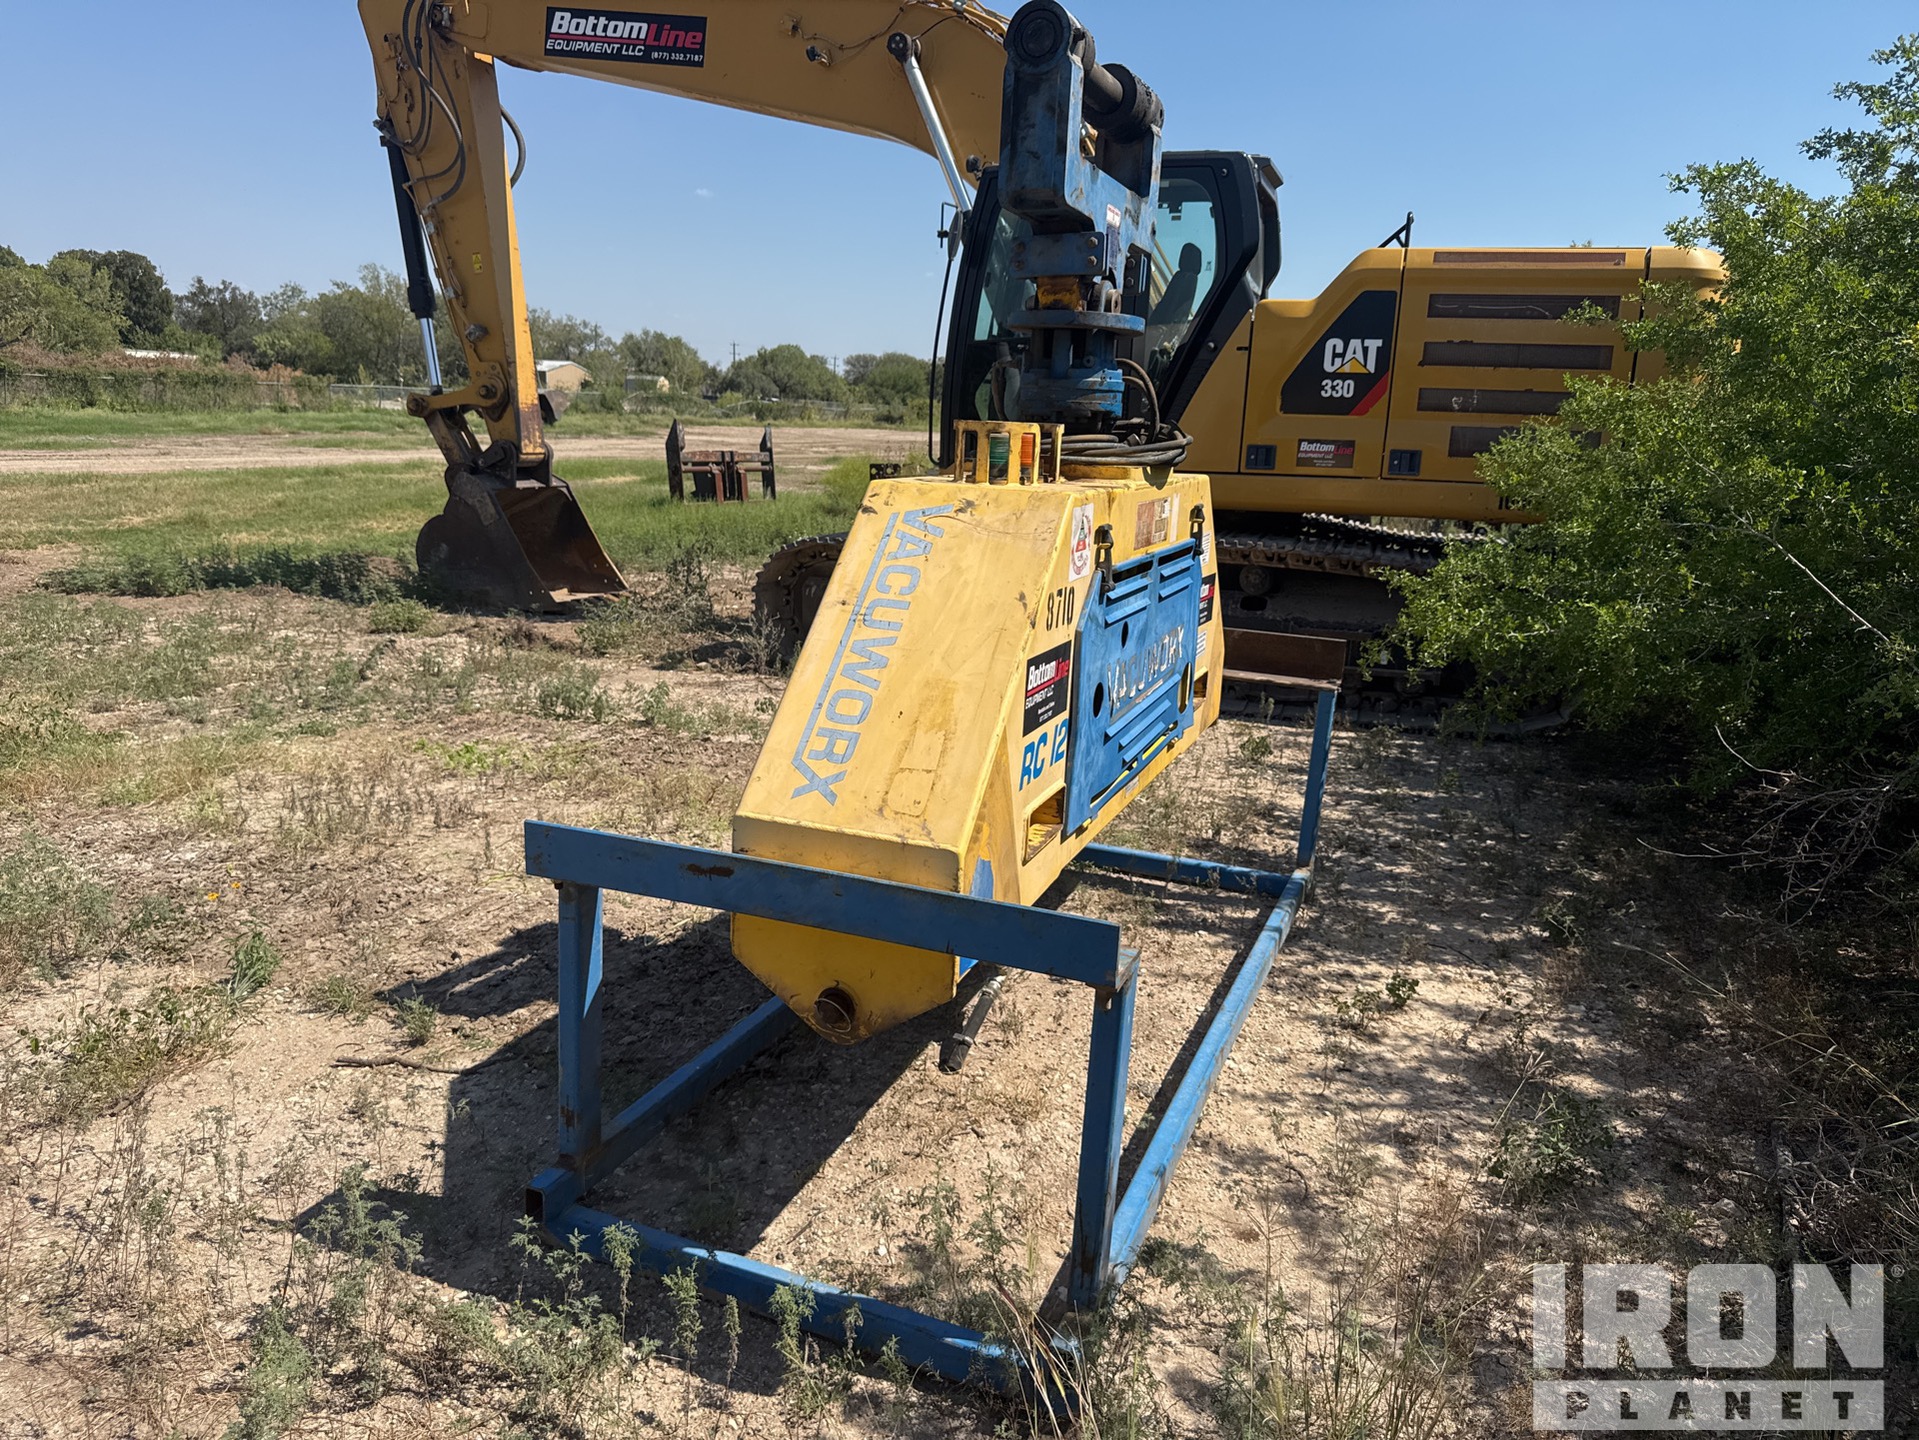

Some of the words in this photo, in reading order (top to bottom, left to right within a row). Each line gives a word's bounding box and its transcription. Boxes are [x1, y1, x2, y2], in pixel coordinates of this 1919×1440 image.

[546, 39, 619, 54] EQUIPMENT
[621, 44, 645, 56] LLC
[651, 51, 669, 61] (877)
[670, 53, 703, 62] 332.7187
[1323, 337, 1383, 374] CAT
[1320, 379, 1355, 398] 330
[791, 504, 954, 806] VACUWORX
[1019, 731, 1048, 792] RC
[1050, 718, 1069, 767] 12
